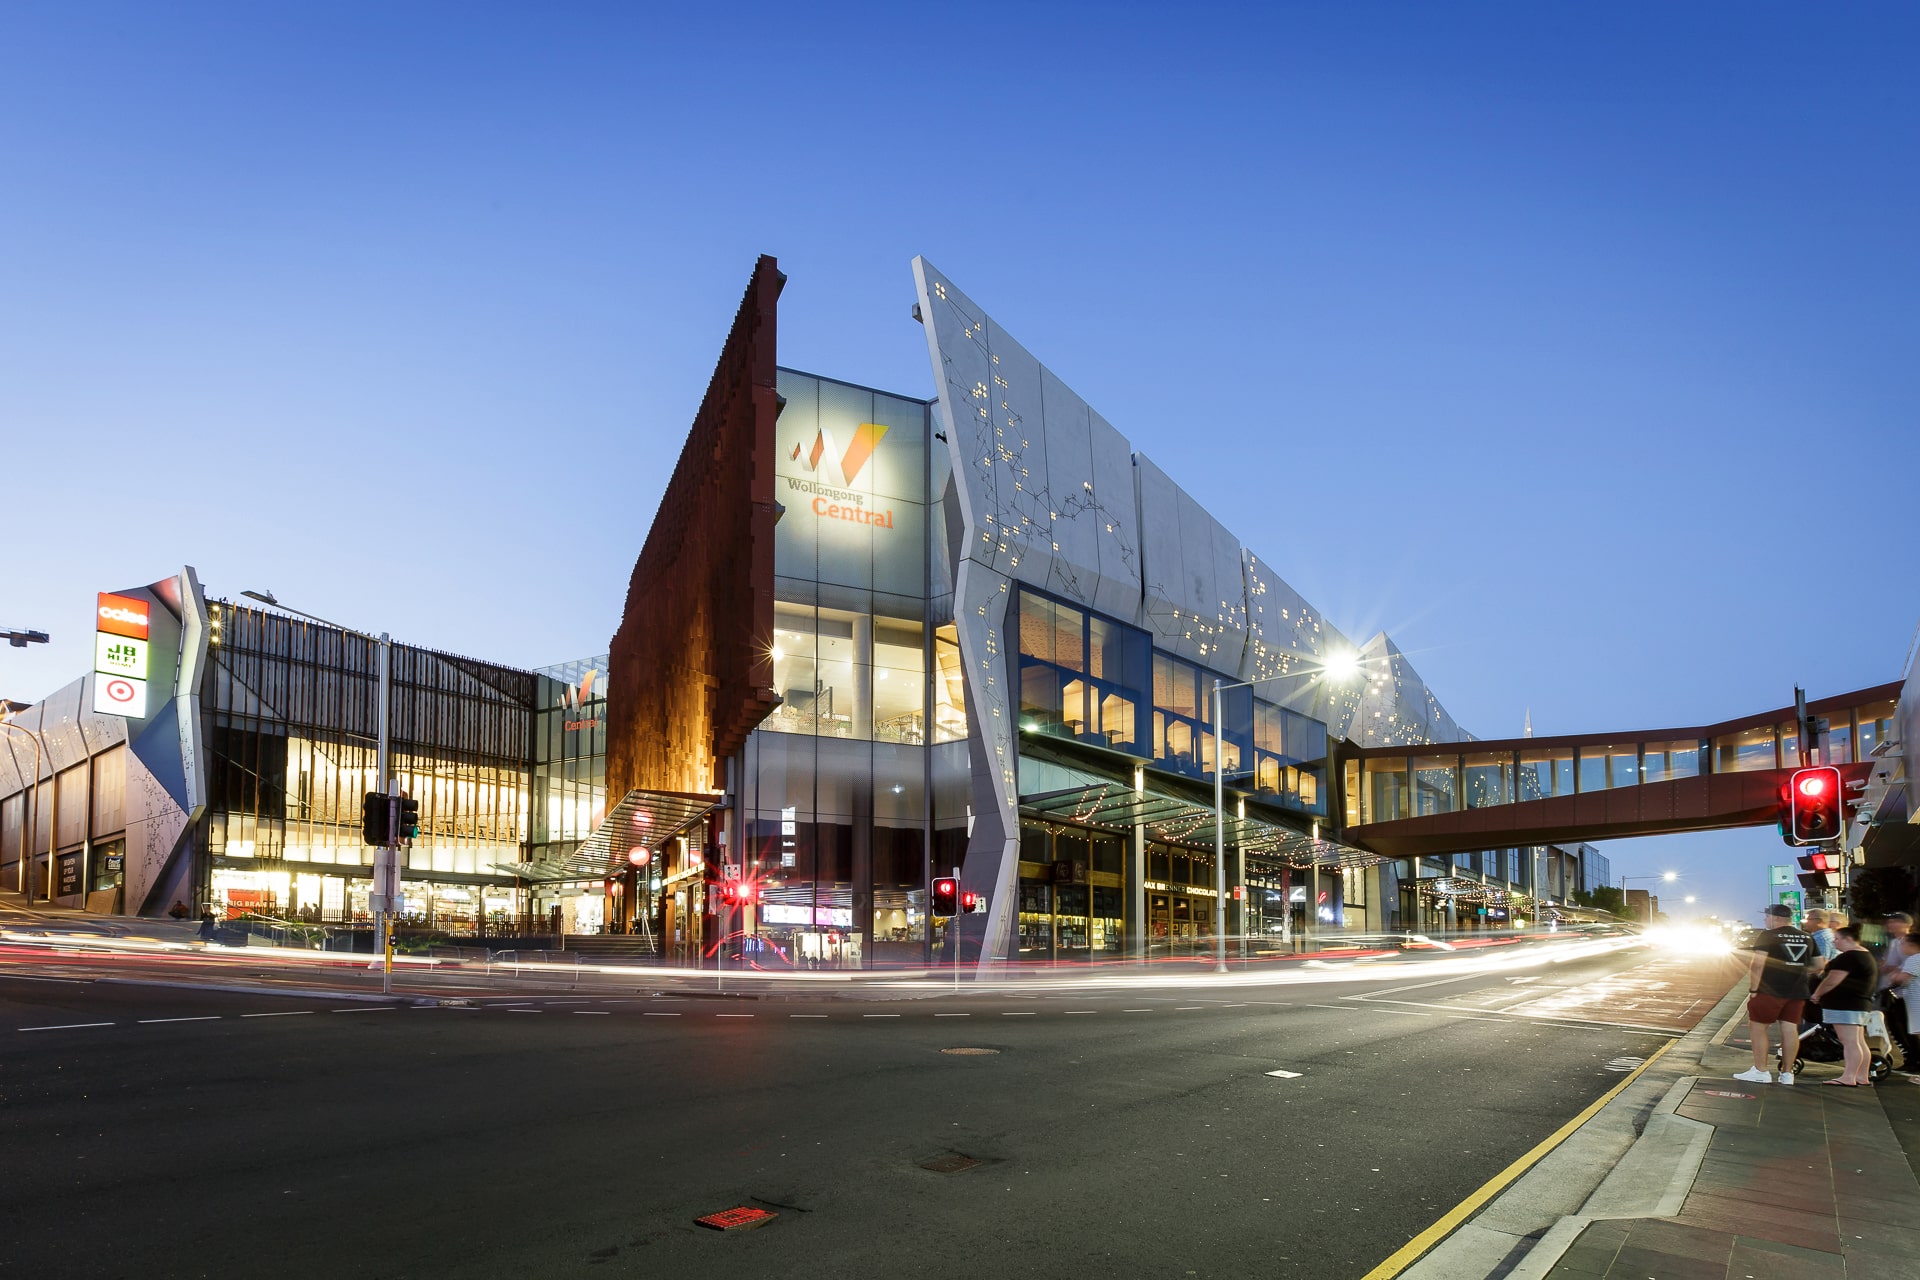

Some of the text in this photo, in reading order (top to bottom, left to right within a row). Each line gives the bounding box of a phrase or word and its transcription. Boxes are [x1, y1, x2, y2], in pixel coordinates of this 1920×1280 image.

[788, 478, 863, 505] Wollongong
[812, 497, 893, 529] Central
[99, 606, 149, 625] coles
[107, 653, 136, 664] HI FI
[108, 644, 136, 656] JB
[565, 712, 599, 732] Central
[1156, 882, 1186, 893] BRENNER
